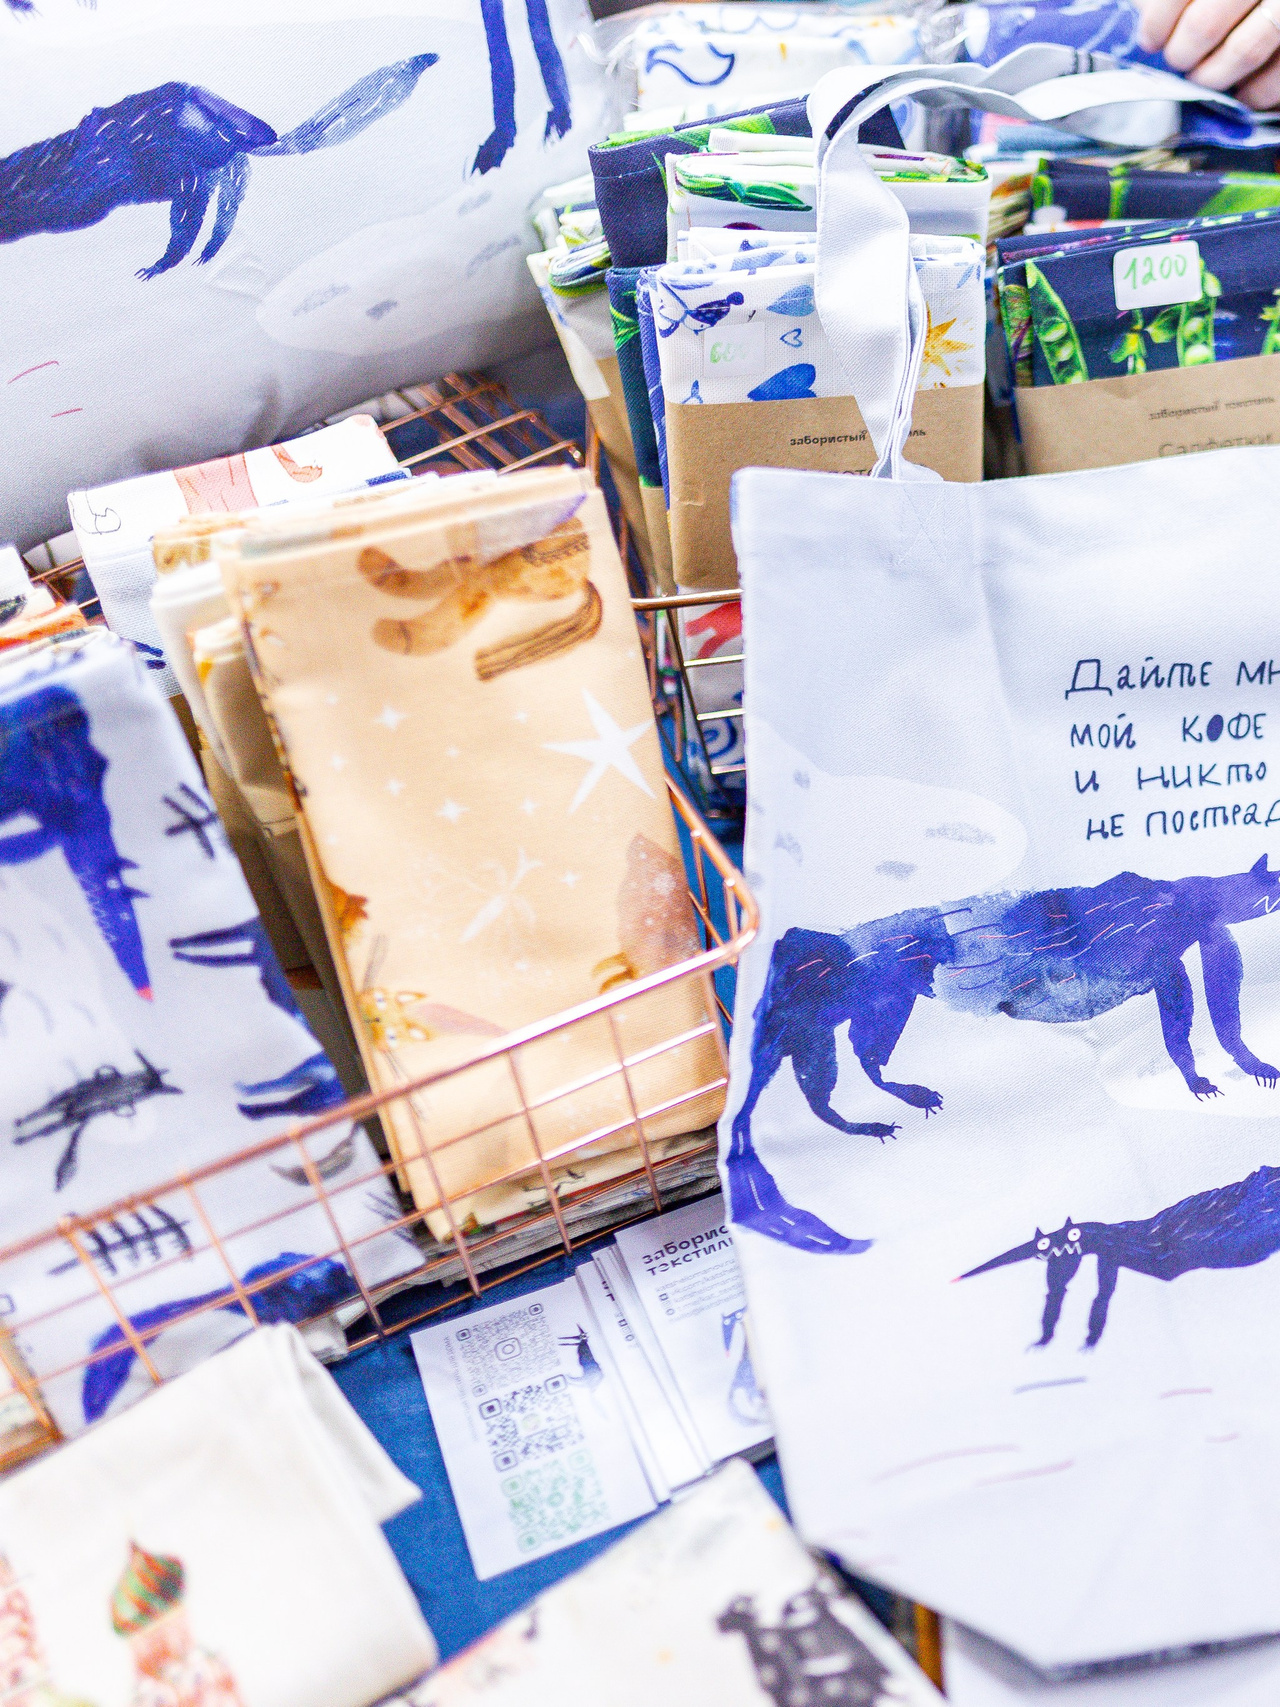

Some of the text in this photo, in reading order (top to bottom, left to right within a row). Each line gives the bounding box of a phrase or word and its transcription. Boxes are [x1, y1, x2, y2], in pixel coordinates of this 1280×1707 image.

[1122, 254, 1187, 289] 1200
[789, 428, 868, 446] забористый
[1065, 656, 1213, 700] Дайте
[1070, 712, 1267, 749] мой кофе
[1074, 761, 1268, 794] и никто
[1086, 812, 1126, 841] не
